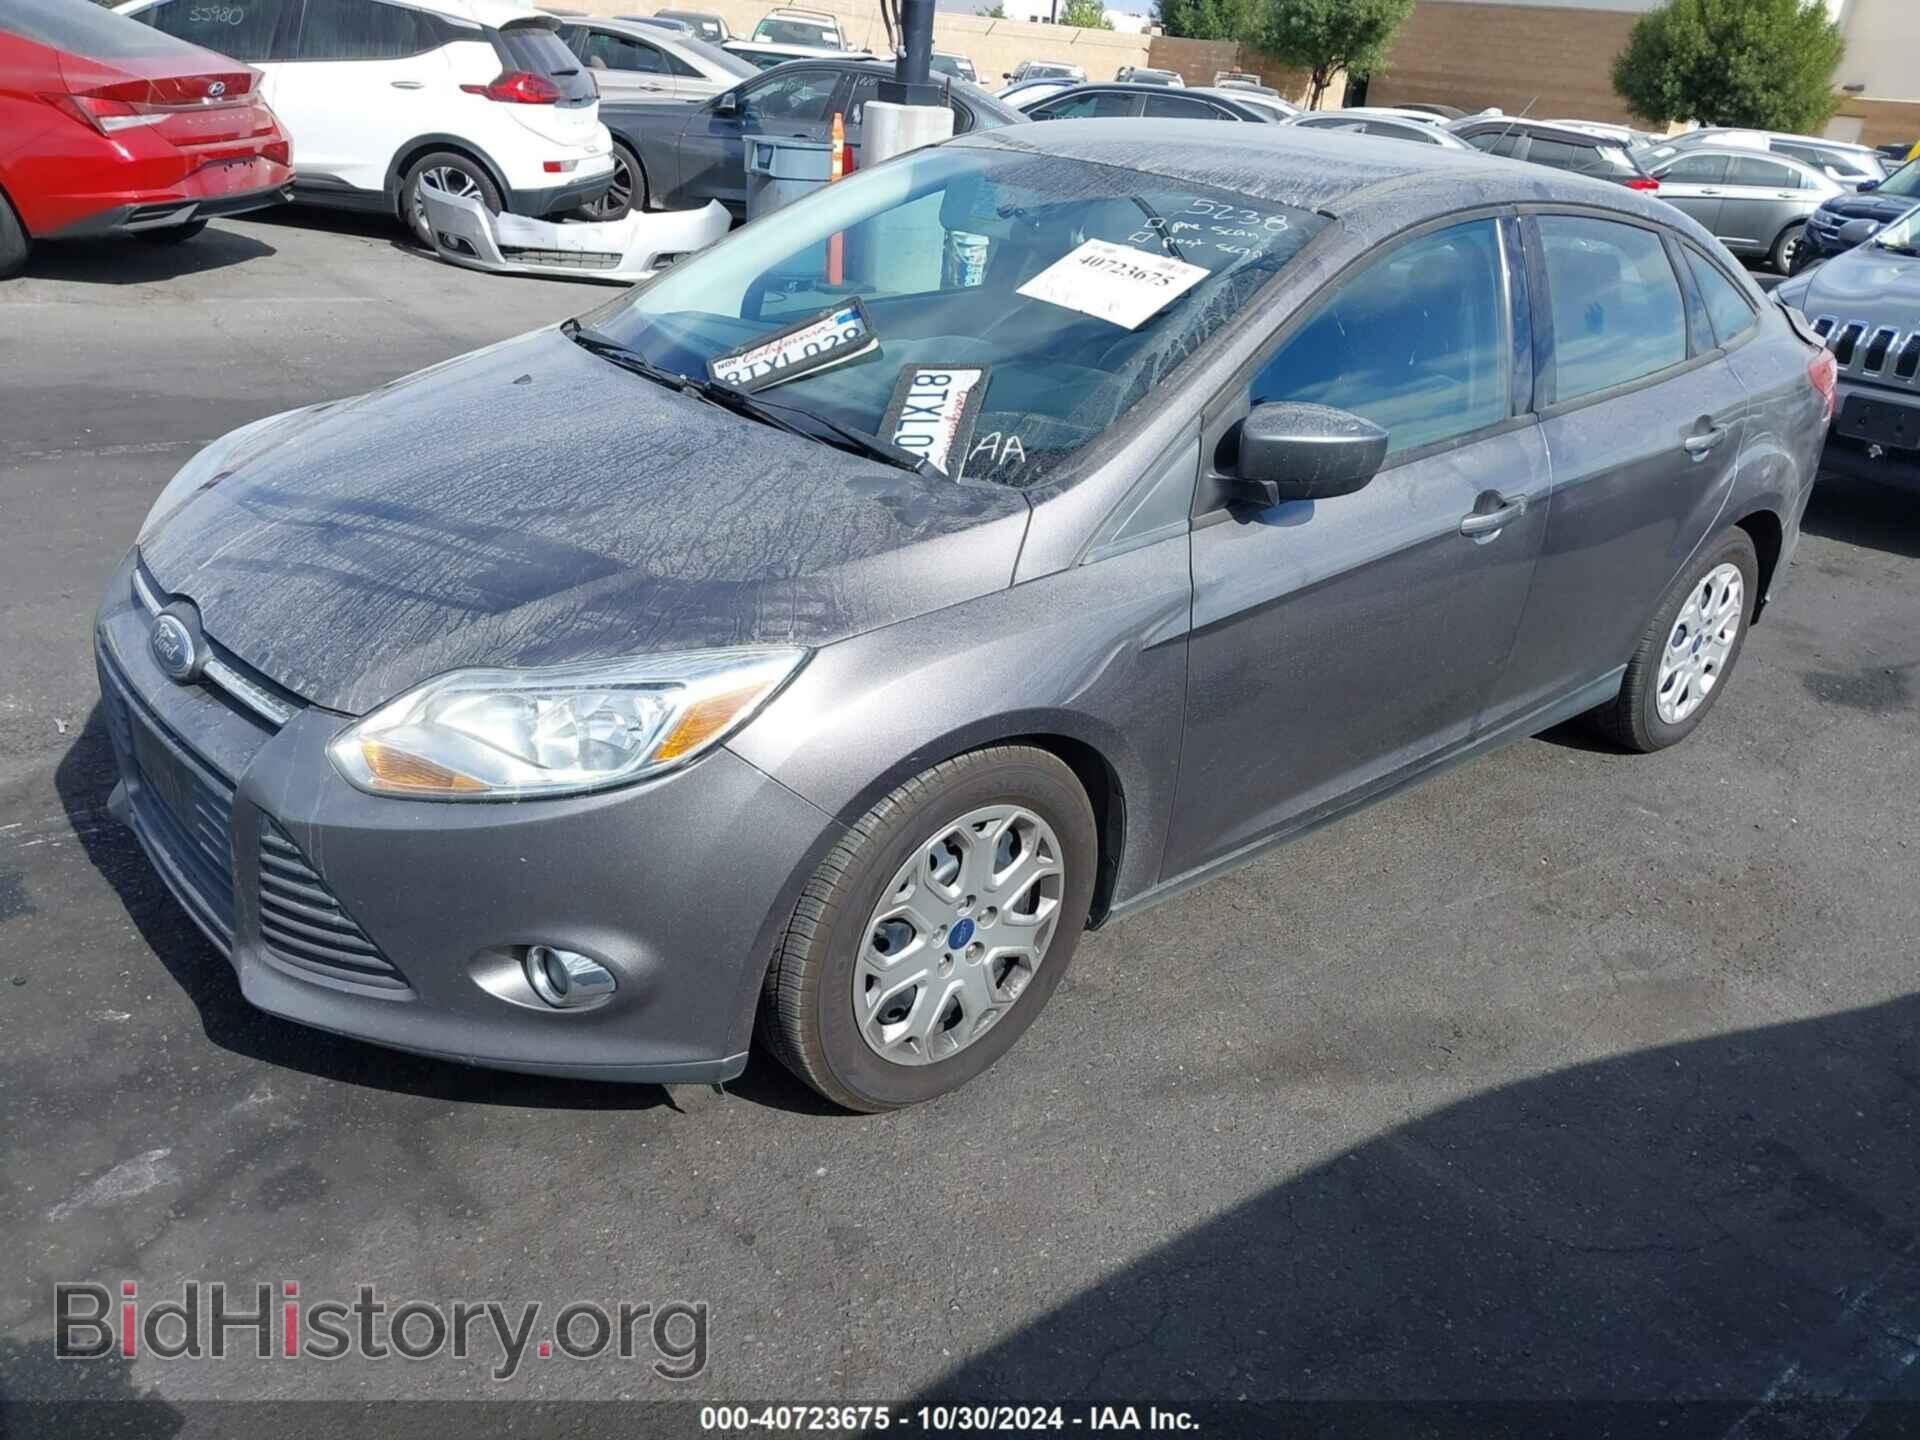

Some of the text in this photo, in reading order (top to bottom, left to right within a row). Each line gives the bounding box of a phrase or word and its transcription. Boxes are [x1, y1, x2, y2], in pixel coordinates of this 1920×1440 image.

[1185, 199, 1289, 232] 5238
[1079, 254, 1176, 287] 40723675
[717, 359, 737, 369] NOV
[969, 431, 1025, 465] AA
